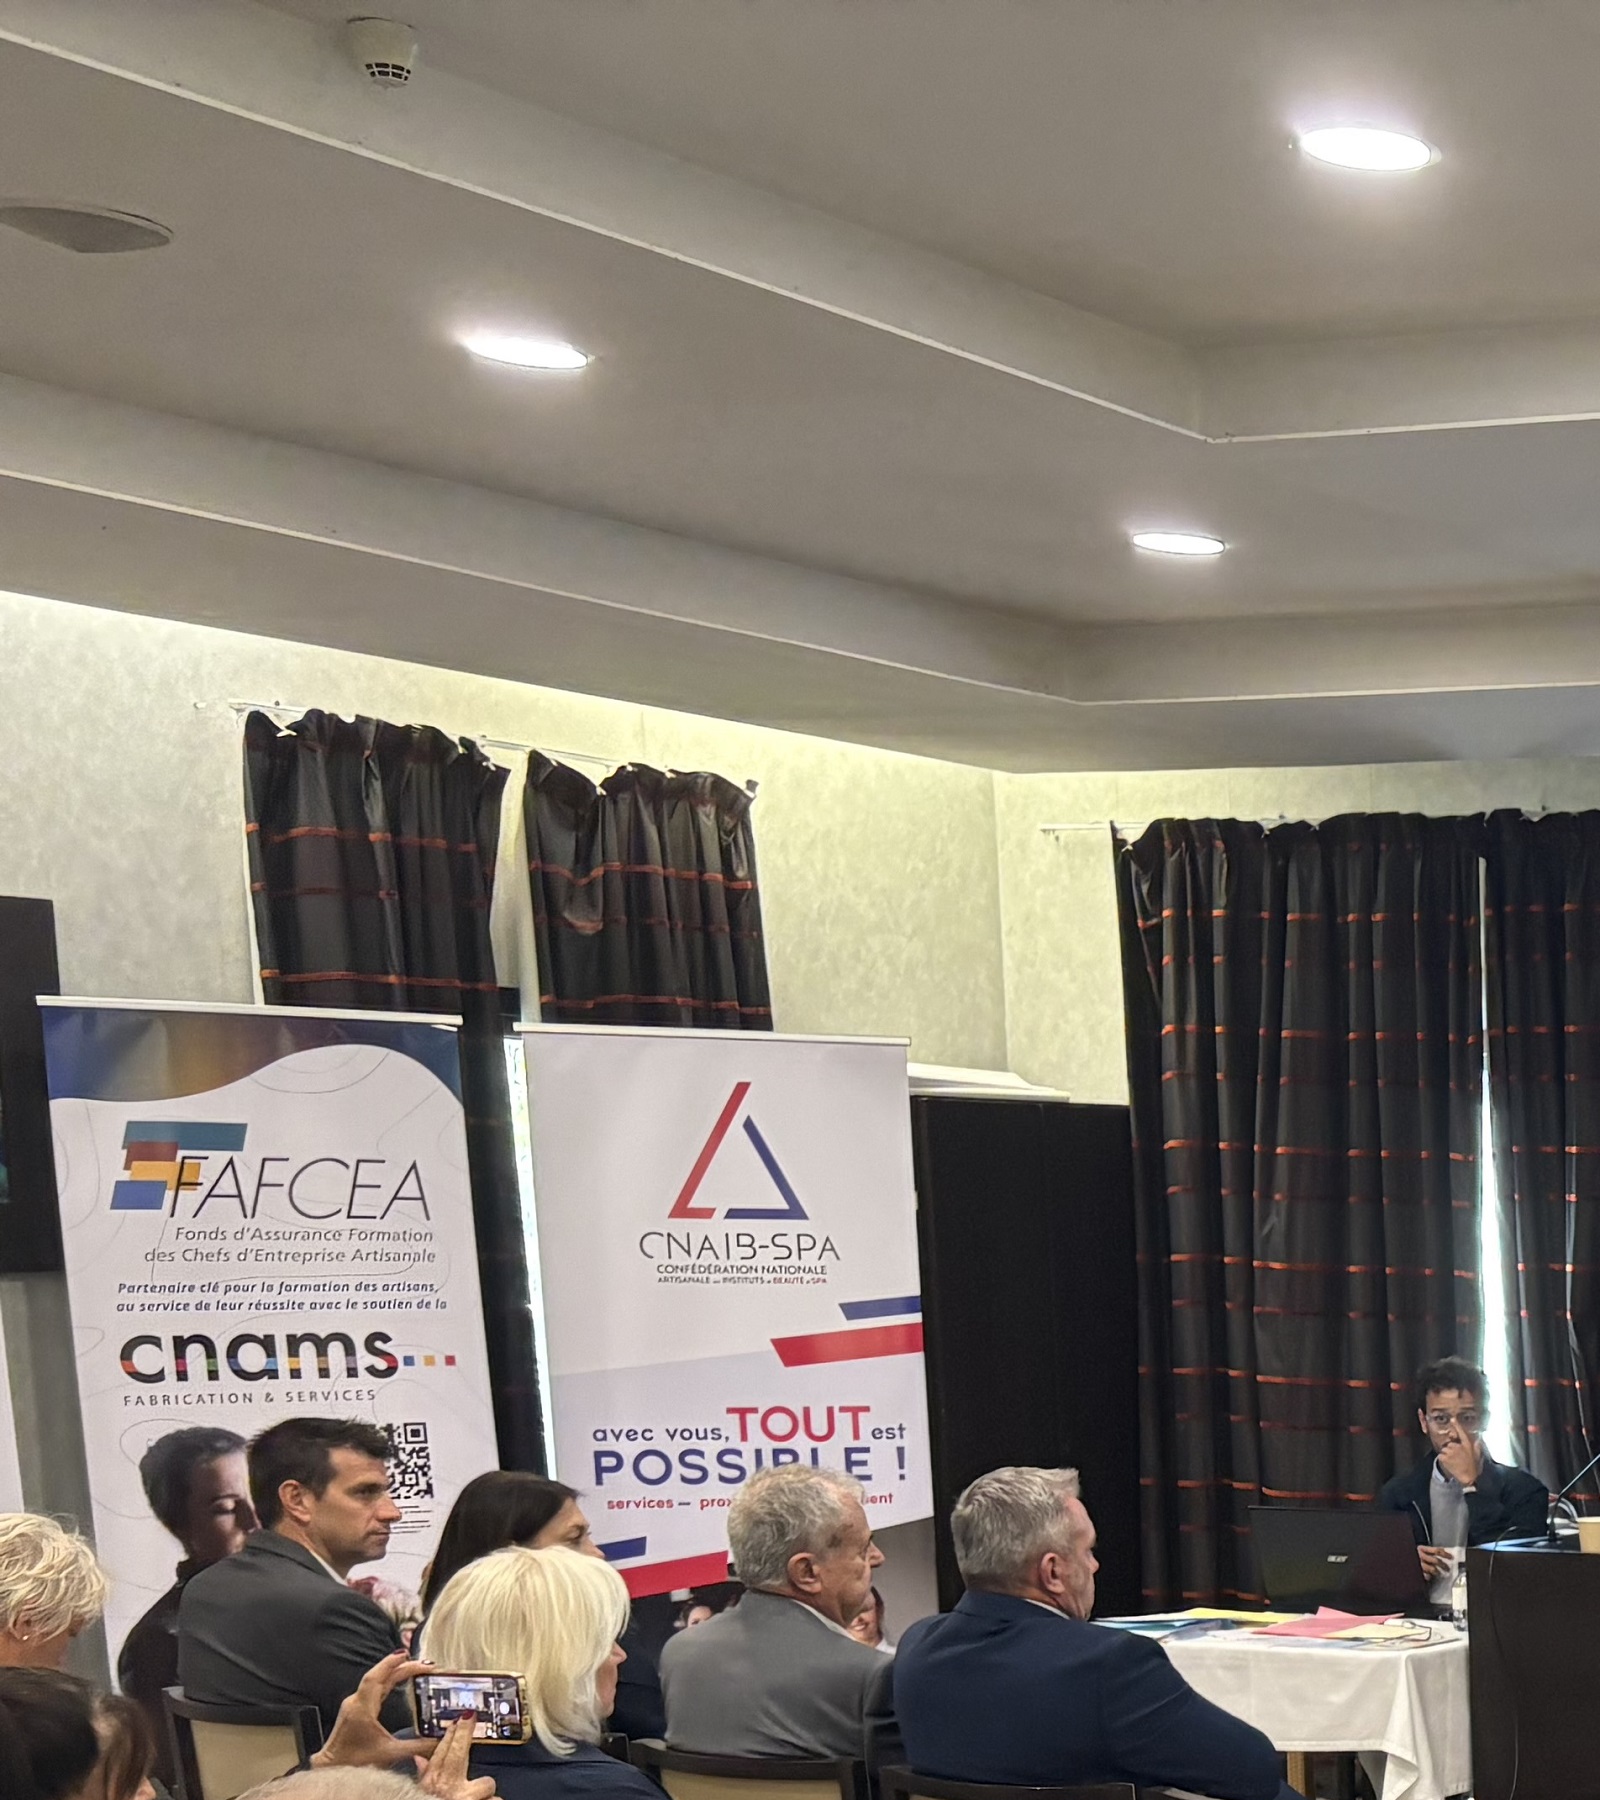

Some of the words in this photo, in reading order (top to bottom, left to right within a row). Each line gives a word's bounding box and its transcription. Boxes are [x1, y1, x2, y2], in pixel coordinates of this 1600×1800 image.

[168, 1154, 431, 1222] FAFCEA
[175, 1226, 228, 1242] Fonds
[232, 1226, 343, 1242] d'Assurance
[347, 1227, 434, 1243] Formation
[638, 1231, 841, 1262] CNAIB-SPA
[144, 1247, 176, 1263] des
[181, 1247, 231, 1263] Chefs
[236, 1247, 346, 1265] d'Entreprise
[350, 1247, 437, 1263] Artisanale
[656, 1263, 759, 1275] CONFÉDÉRATION
[761, 1264, 828, 1275] NATIONALE
[118, 1281, 196, 1294] Partenaire
[199, 1280, 220, 1294] clé
[223, 1282, 257, 1296] pour
[260, 1281, 275, 1293] la
[276, 1280, 350, 1296] formation
[354, 1280, 378, 1293] des
[381, 1280, 439, 1294] artisans,
[116, 1301, 135, 1312] au
[138, 1299, 191, 1312] service
[194, 1299, 212, 1312] de
[215, 1299, 244, 1312] leur
[247, 1298, 306, 1311] réussite
[309, 1300, 343, 1311] avec
[345, 1298, 359, 1310] le
[362, 1297, 413, 1311] soutien
[416, 1297, 433, 1310] de
[434, 1298, 448, 1310] la
[119, 1331, 400, 1384] cnams
[122, 1391, 254, 1408] FABRICATION
[264, 1391, 275, 1404] &
[285, 1389, 377, 1404] SERVICES
[592, 1426, 655, 1442] avec
[665, 1426, 731, 1444] vous,
[725, 1405, 871, 1443] TOUT
[871, 1421, 907, 1441] est
[606, 1496, 675, 1511] services
